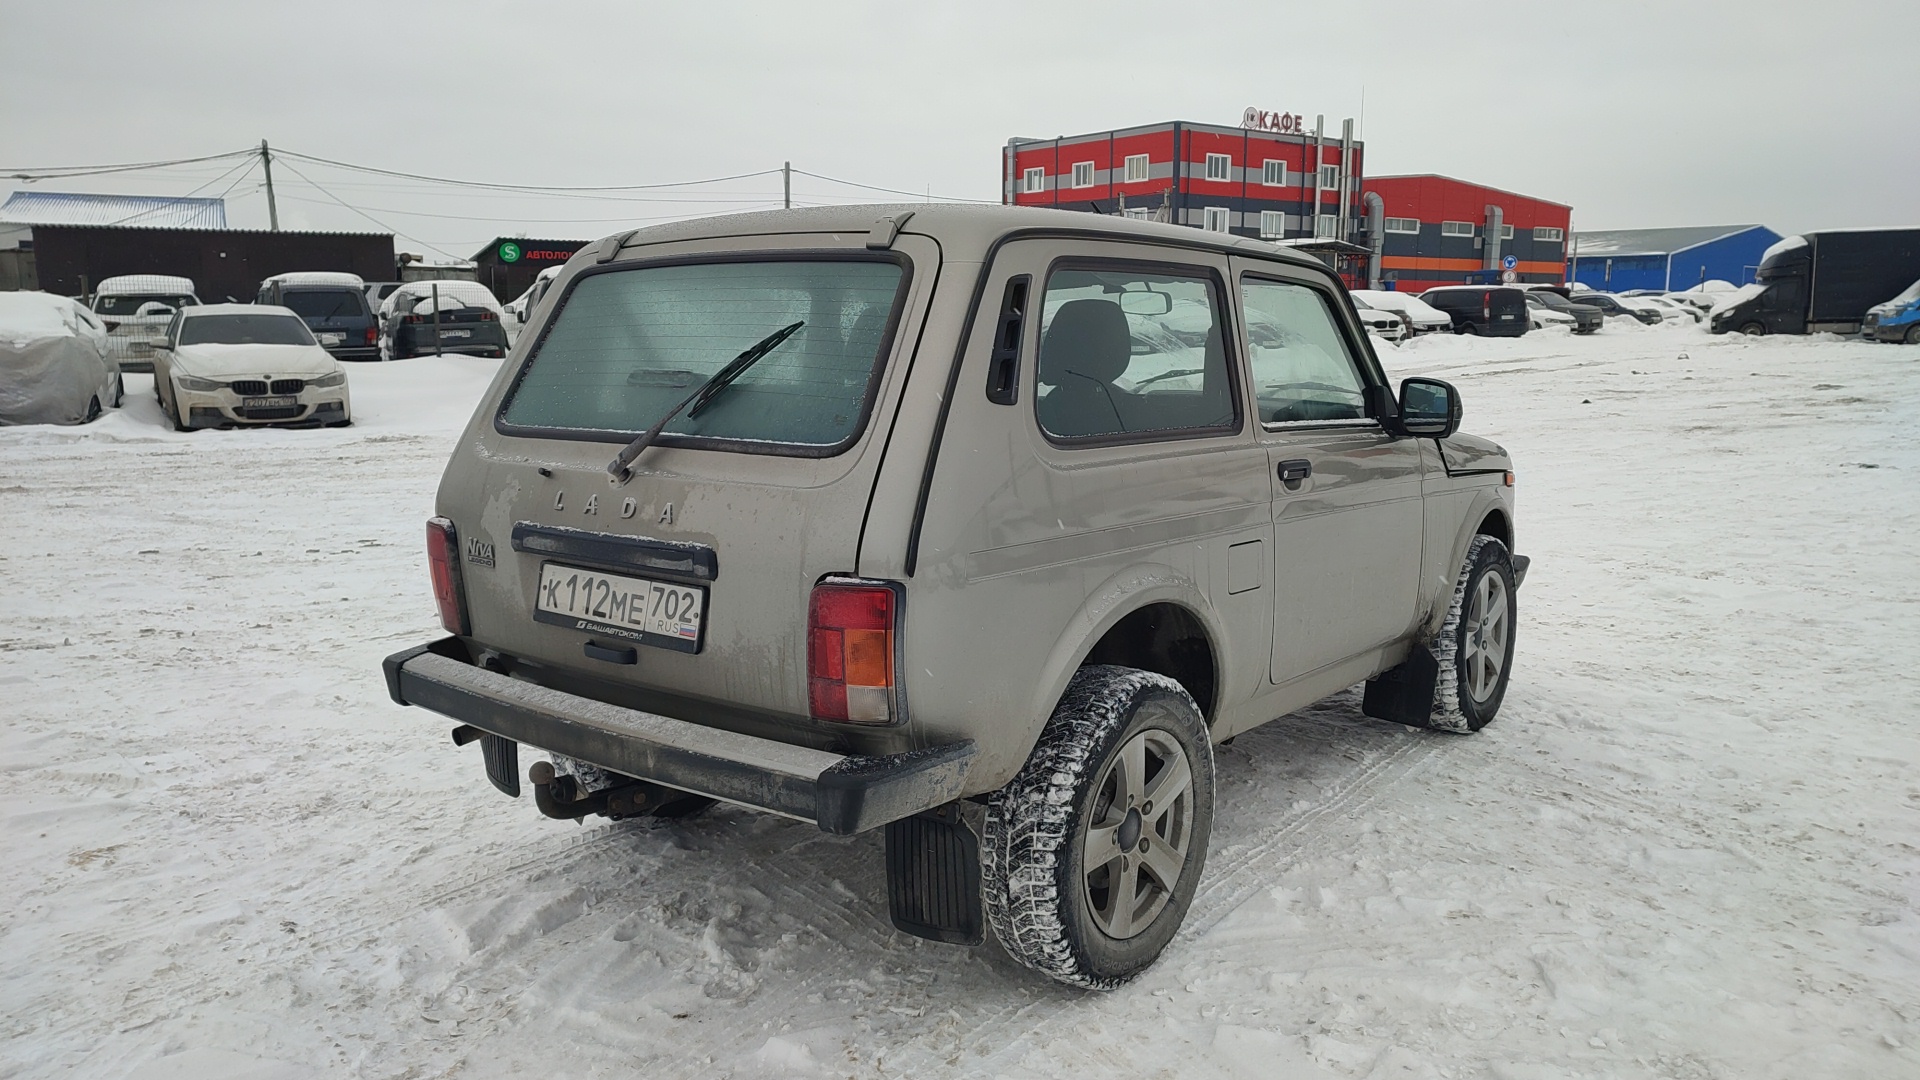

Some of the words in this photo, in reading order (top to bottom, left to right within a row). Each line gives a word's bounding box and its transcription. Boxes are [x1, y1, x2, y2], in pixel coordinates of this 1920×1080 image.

[1259, 110, 1302, 132] КАФЕ
[554, 490, 673, 524] LADA
[467, 536, 494, 558] NIVA
[546, 574, 644, 626] К112МЕ
[651, 586, 695, 624] 702
[586, 622, 643, 641] БАШАВТОКОМ
[657, 620, 679, 634] RUS
